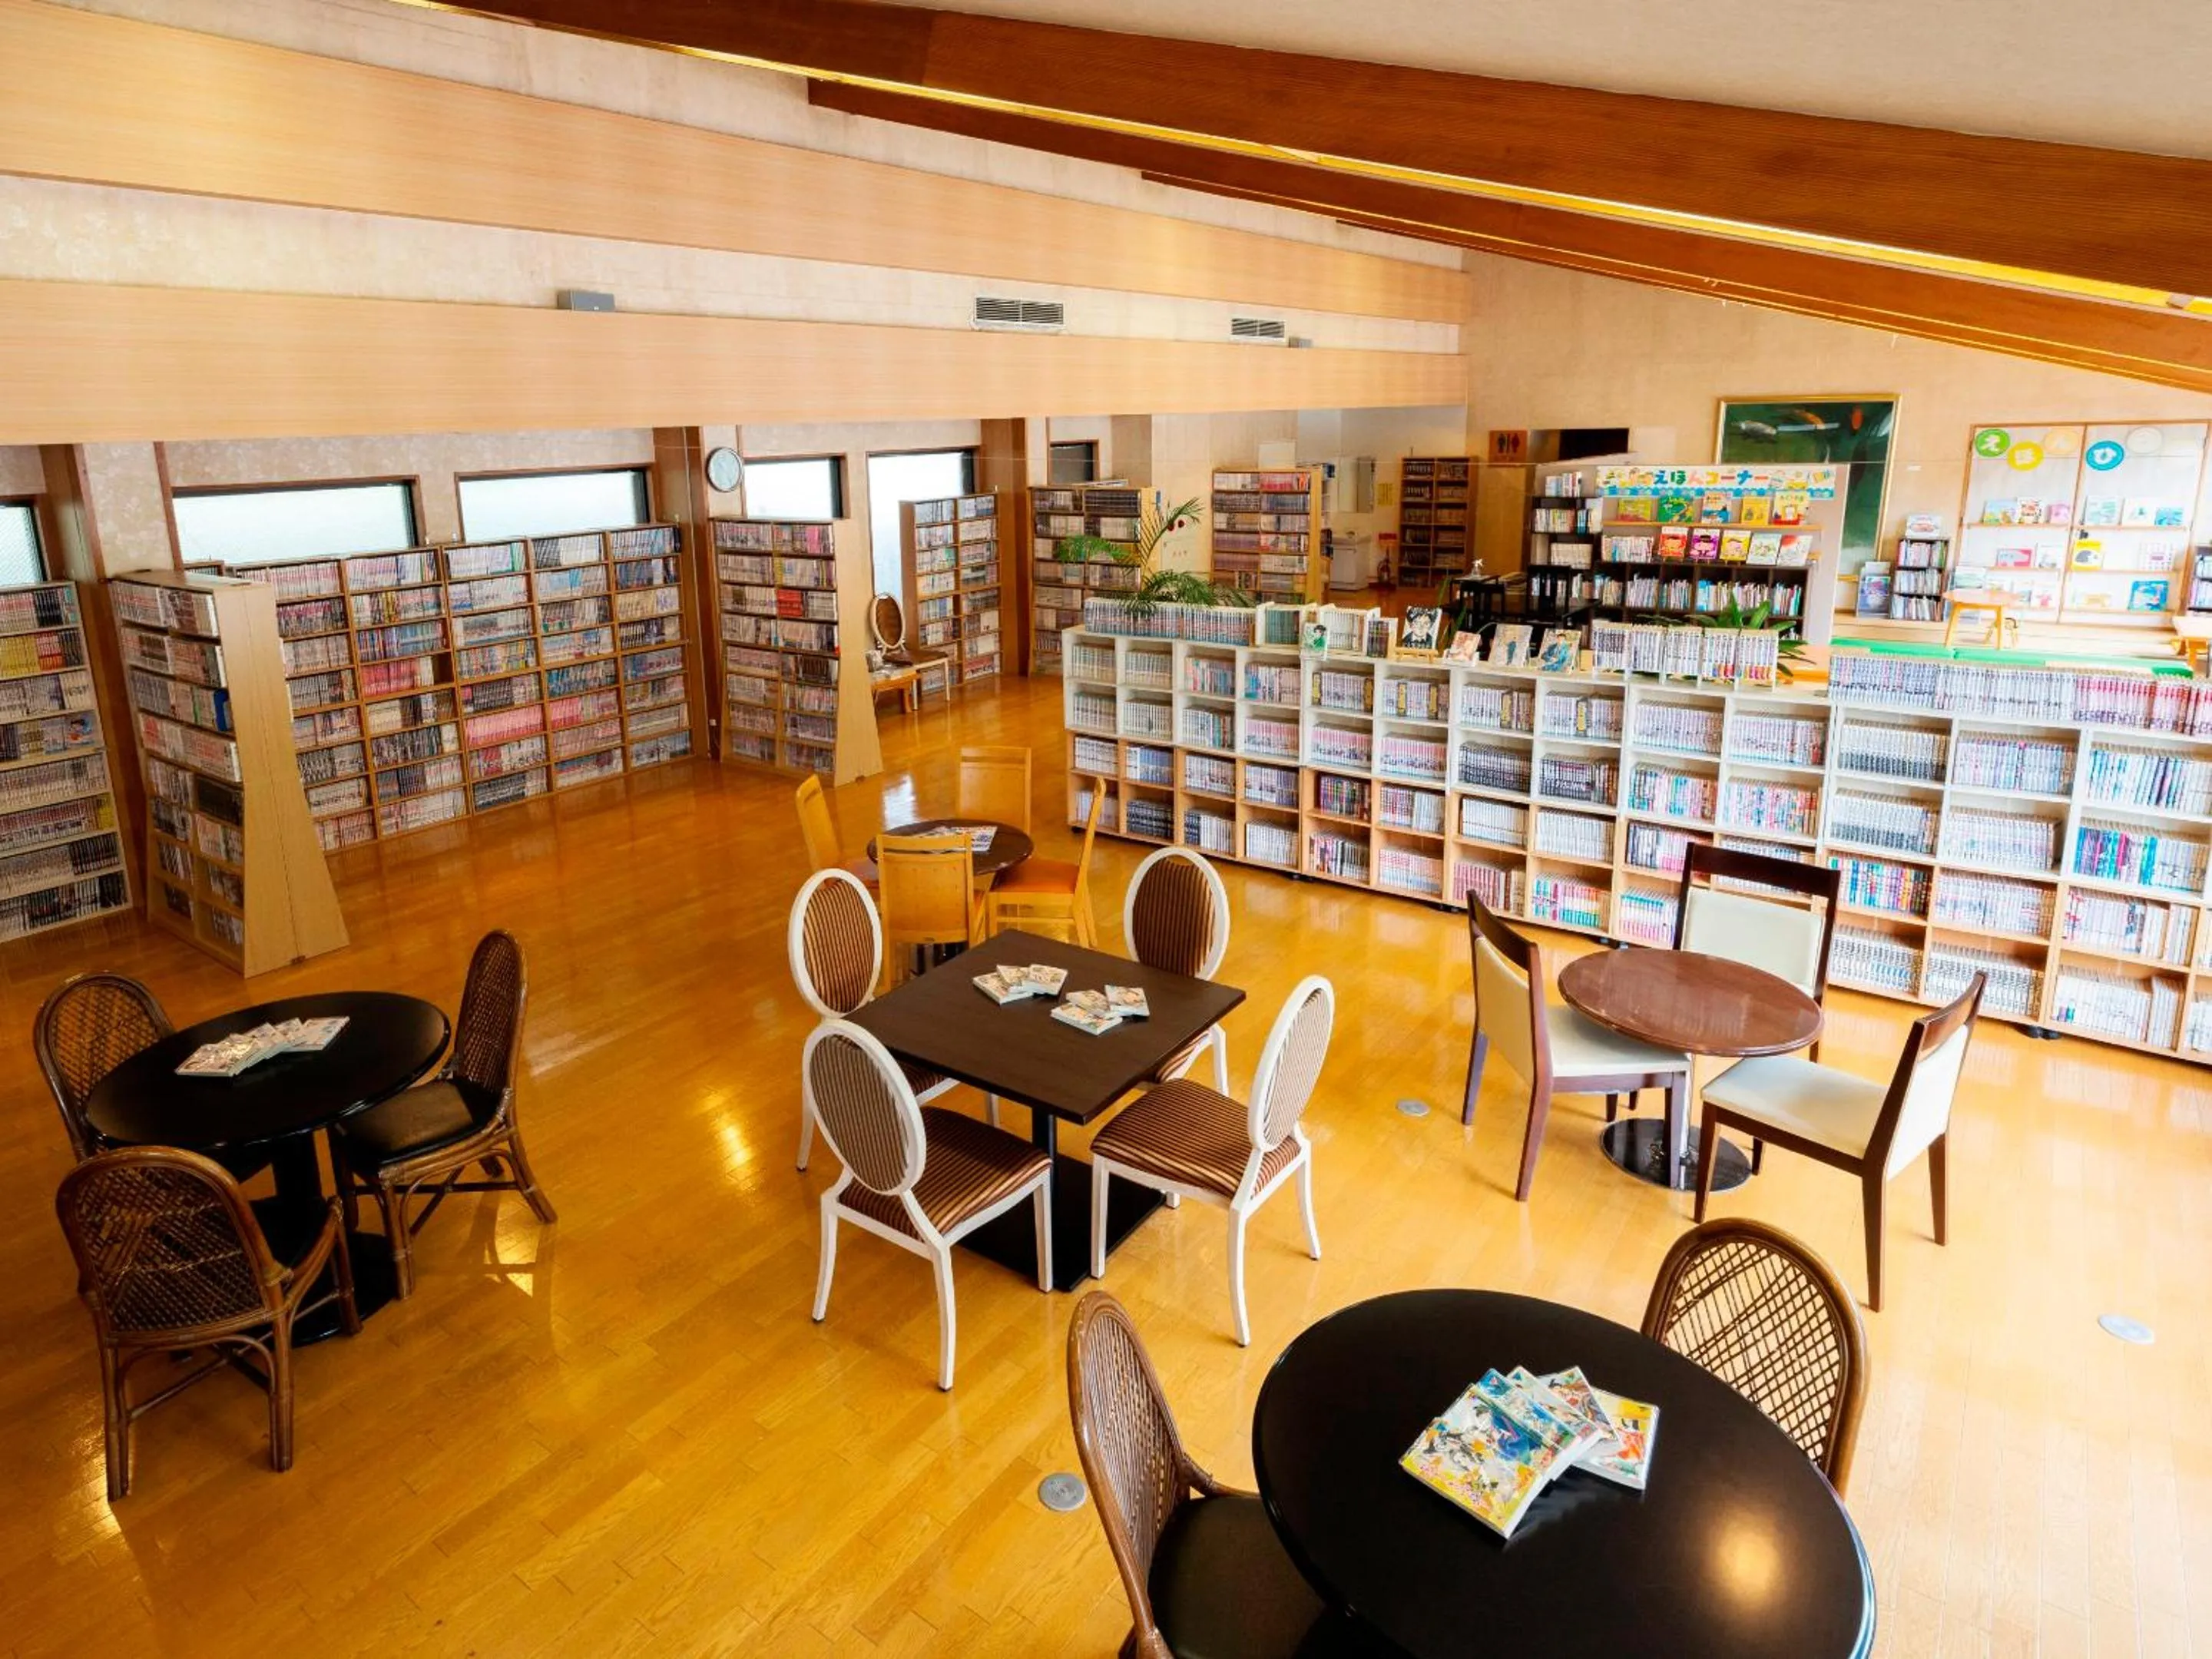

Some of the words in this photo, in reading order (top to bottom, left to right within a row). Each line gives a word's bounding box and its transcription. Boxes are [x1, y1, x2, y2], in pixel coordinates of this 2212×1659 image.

[1654, 469, 1769, 485] えほんコーナー
